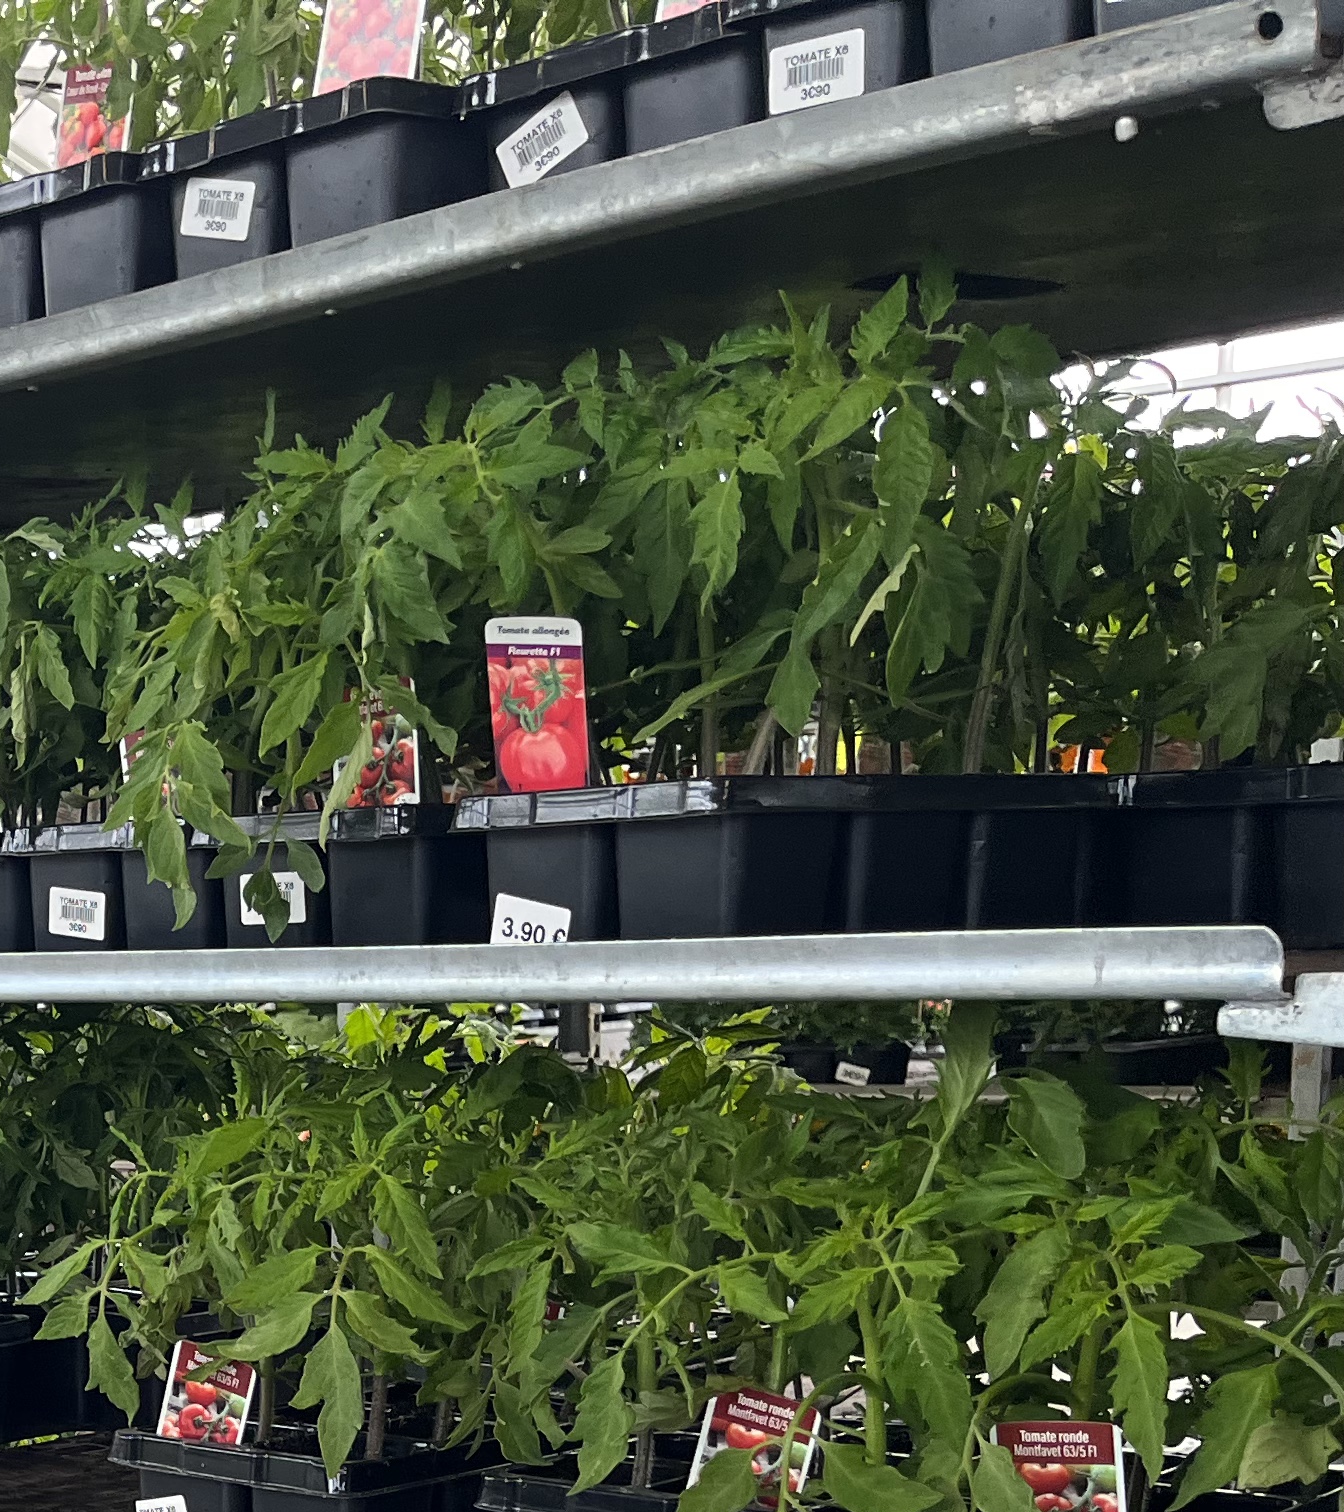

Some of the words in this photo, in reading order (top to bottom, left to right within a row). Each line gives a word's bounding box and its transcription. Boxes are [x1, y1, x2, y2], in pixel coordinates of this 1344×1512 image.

[785, 49, 833, 68] TOMATE
[511, 119, 550, 152] TOMATE
[198, 188, 233, 200] TOMATE
[497, 626, 530, 636] Tomate
[58, 896, 88, 908] TOMATE
[501, 916, 547, 944] 3.90
[737, 1392, 768, 1413] Tomate
[768, 1402, 796, 1420] ronde
[1019, 1429, 1058, 1444] Tomate
[1058, 1430, 1090, 1444] ronde
[1013, 1443, 1061, 1457] Montfavet
[1062, 1446, 1087, 1458] 63/5
